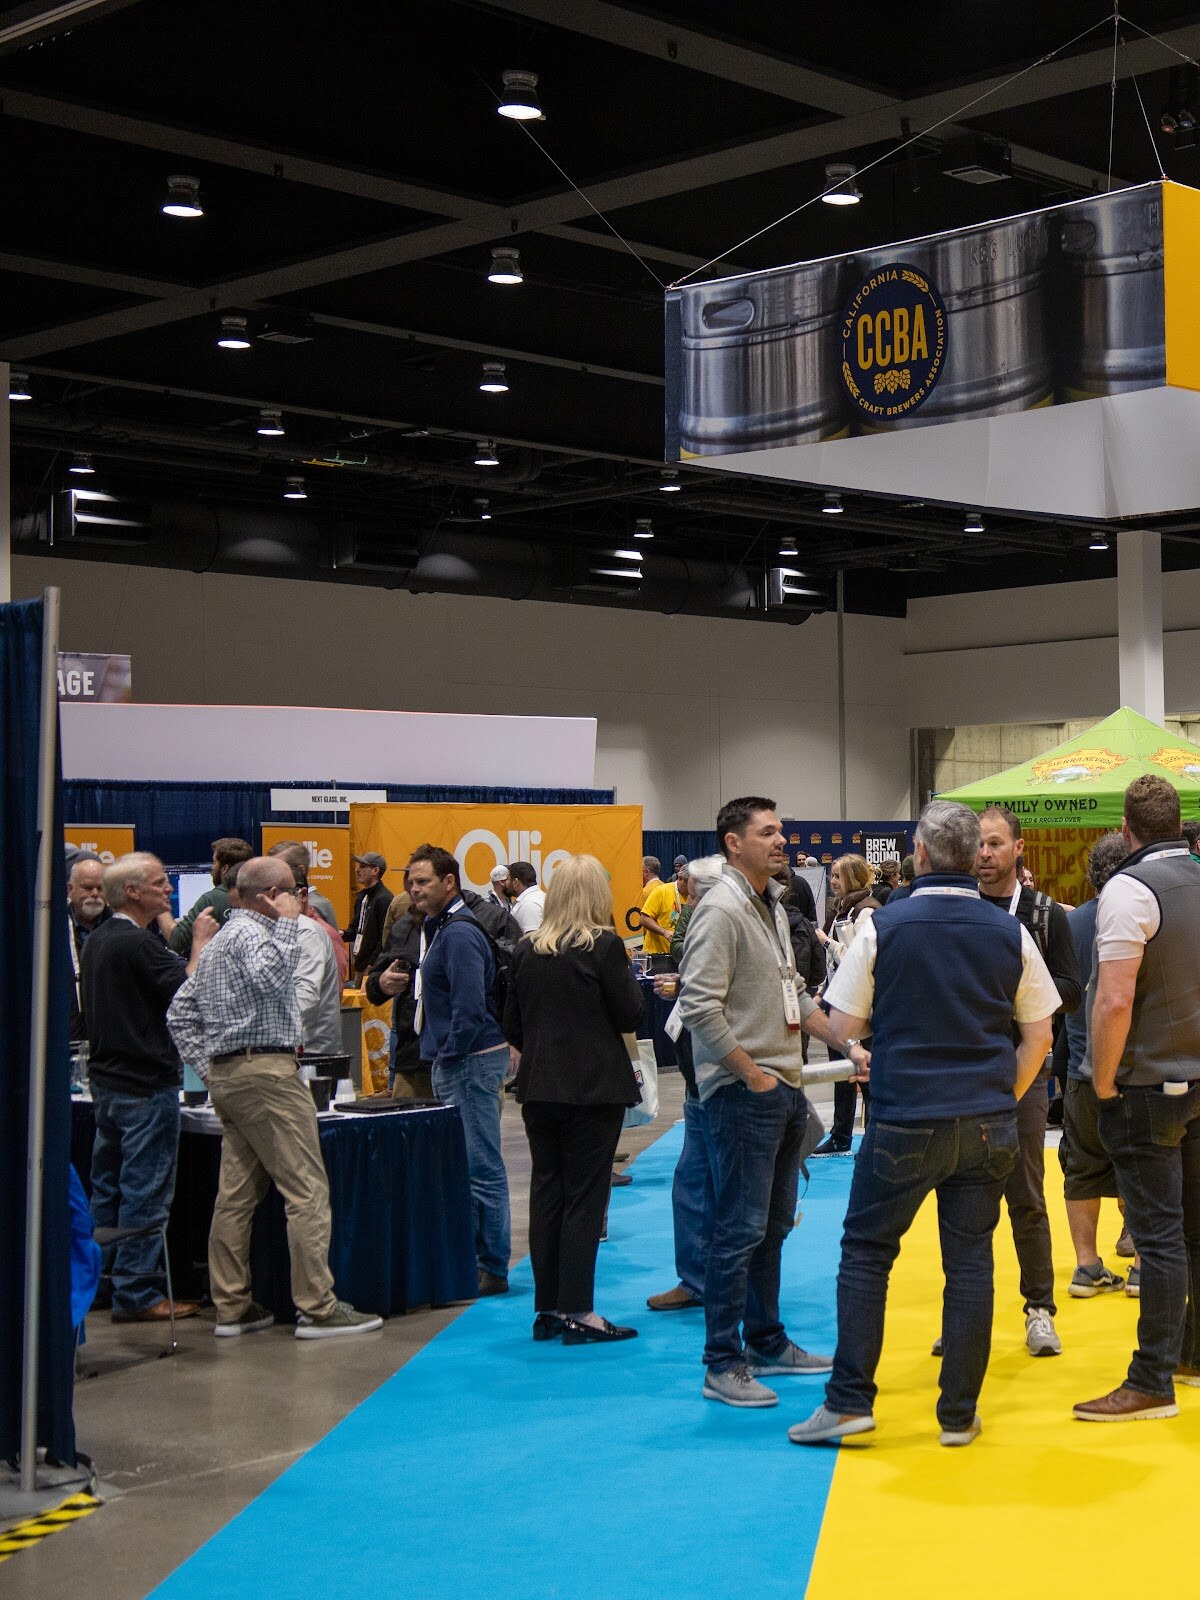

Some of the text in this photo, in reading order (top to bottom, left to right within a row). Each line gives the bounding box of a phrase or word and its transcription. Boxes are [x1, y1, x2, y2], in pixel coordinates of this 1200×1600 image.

[843, 269, 898, 338] CALIFORNIA
[857, 303, 928, 370] CCBA
[859, 309, 944, 415] CRAFT BREWERS ASSOCIATION
[1044, 798, 1098, 813] OWNED
[866, 839, 896, 851] BREW
[866, 851, 900, 864] BOUND
